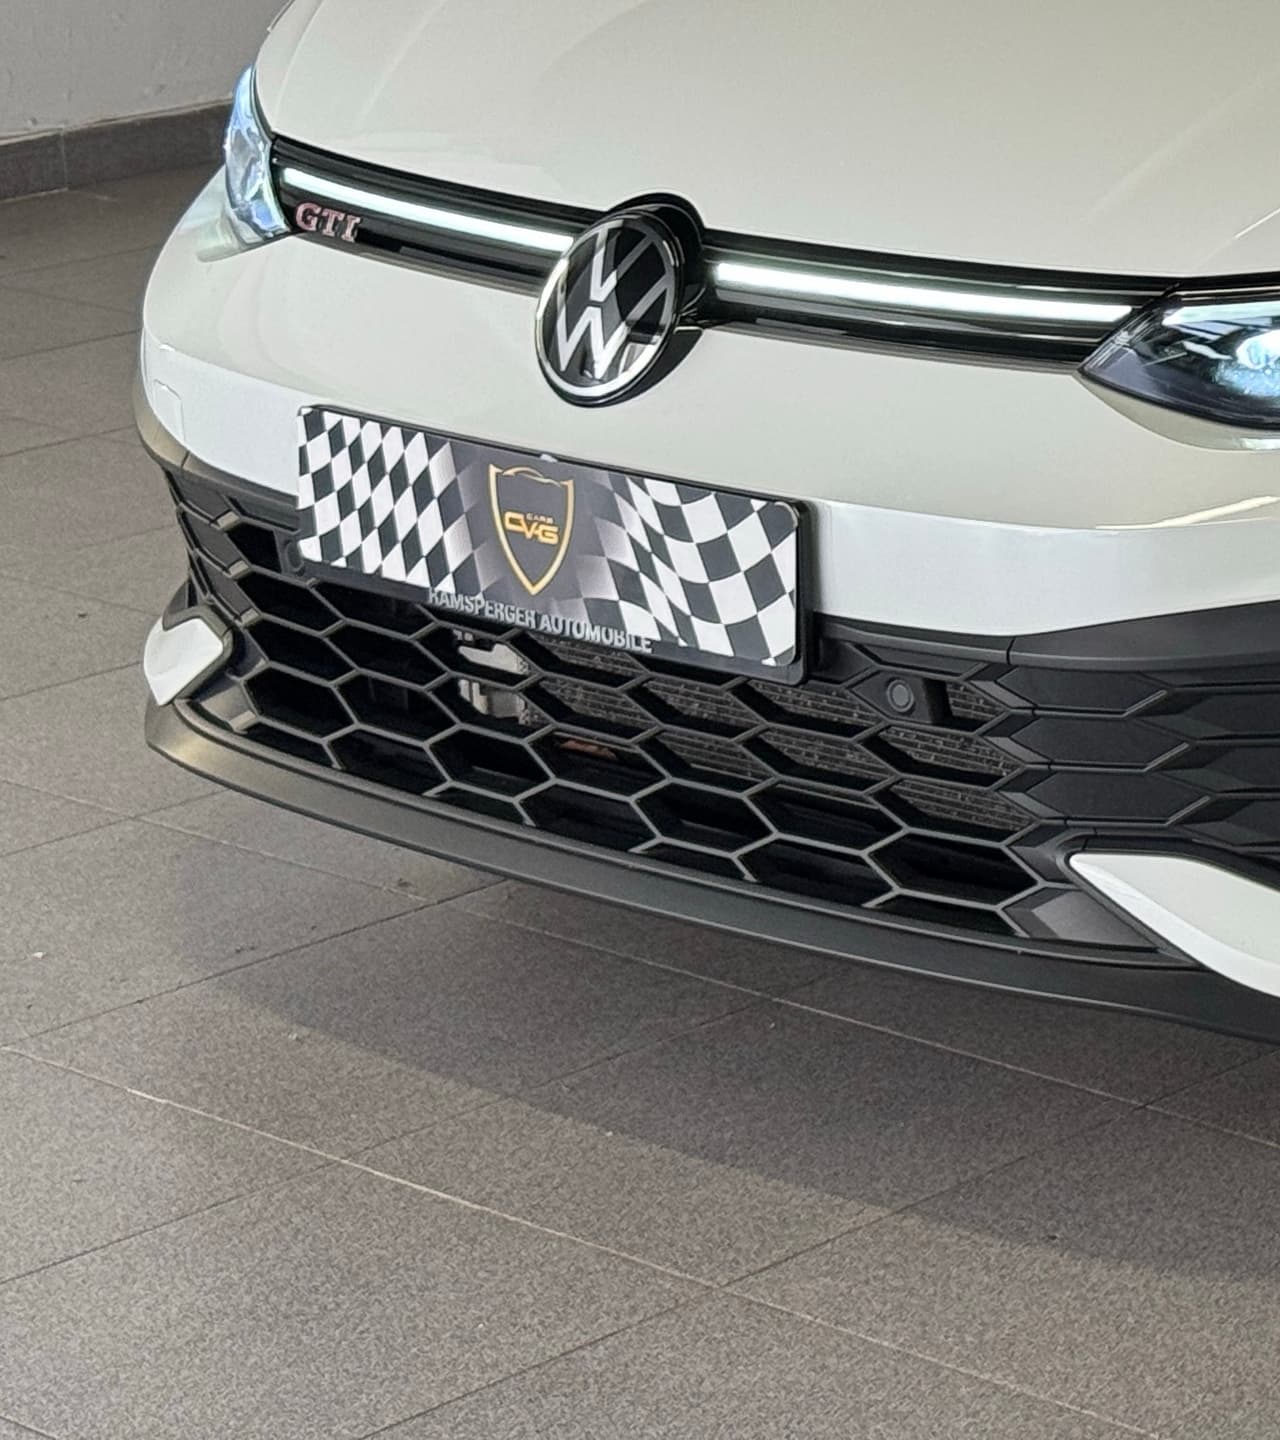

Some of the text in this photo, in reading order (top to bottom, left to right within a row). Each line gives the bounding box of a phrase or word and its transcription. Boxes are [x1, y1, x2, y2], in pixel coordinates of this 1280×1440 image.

[295, 201, 361, 243] GTI
[505, 511, 559, 544] CVG
[539, 613, 653, 654] AUTOMOBILE
